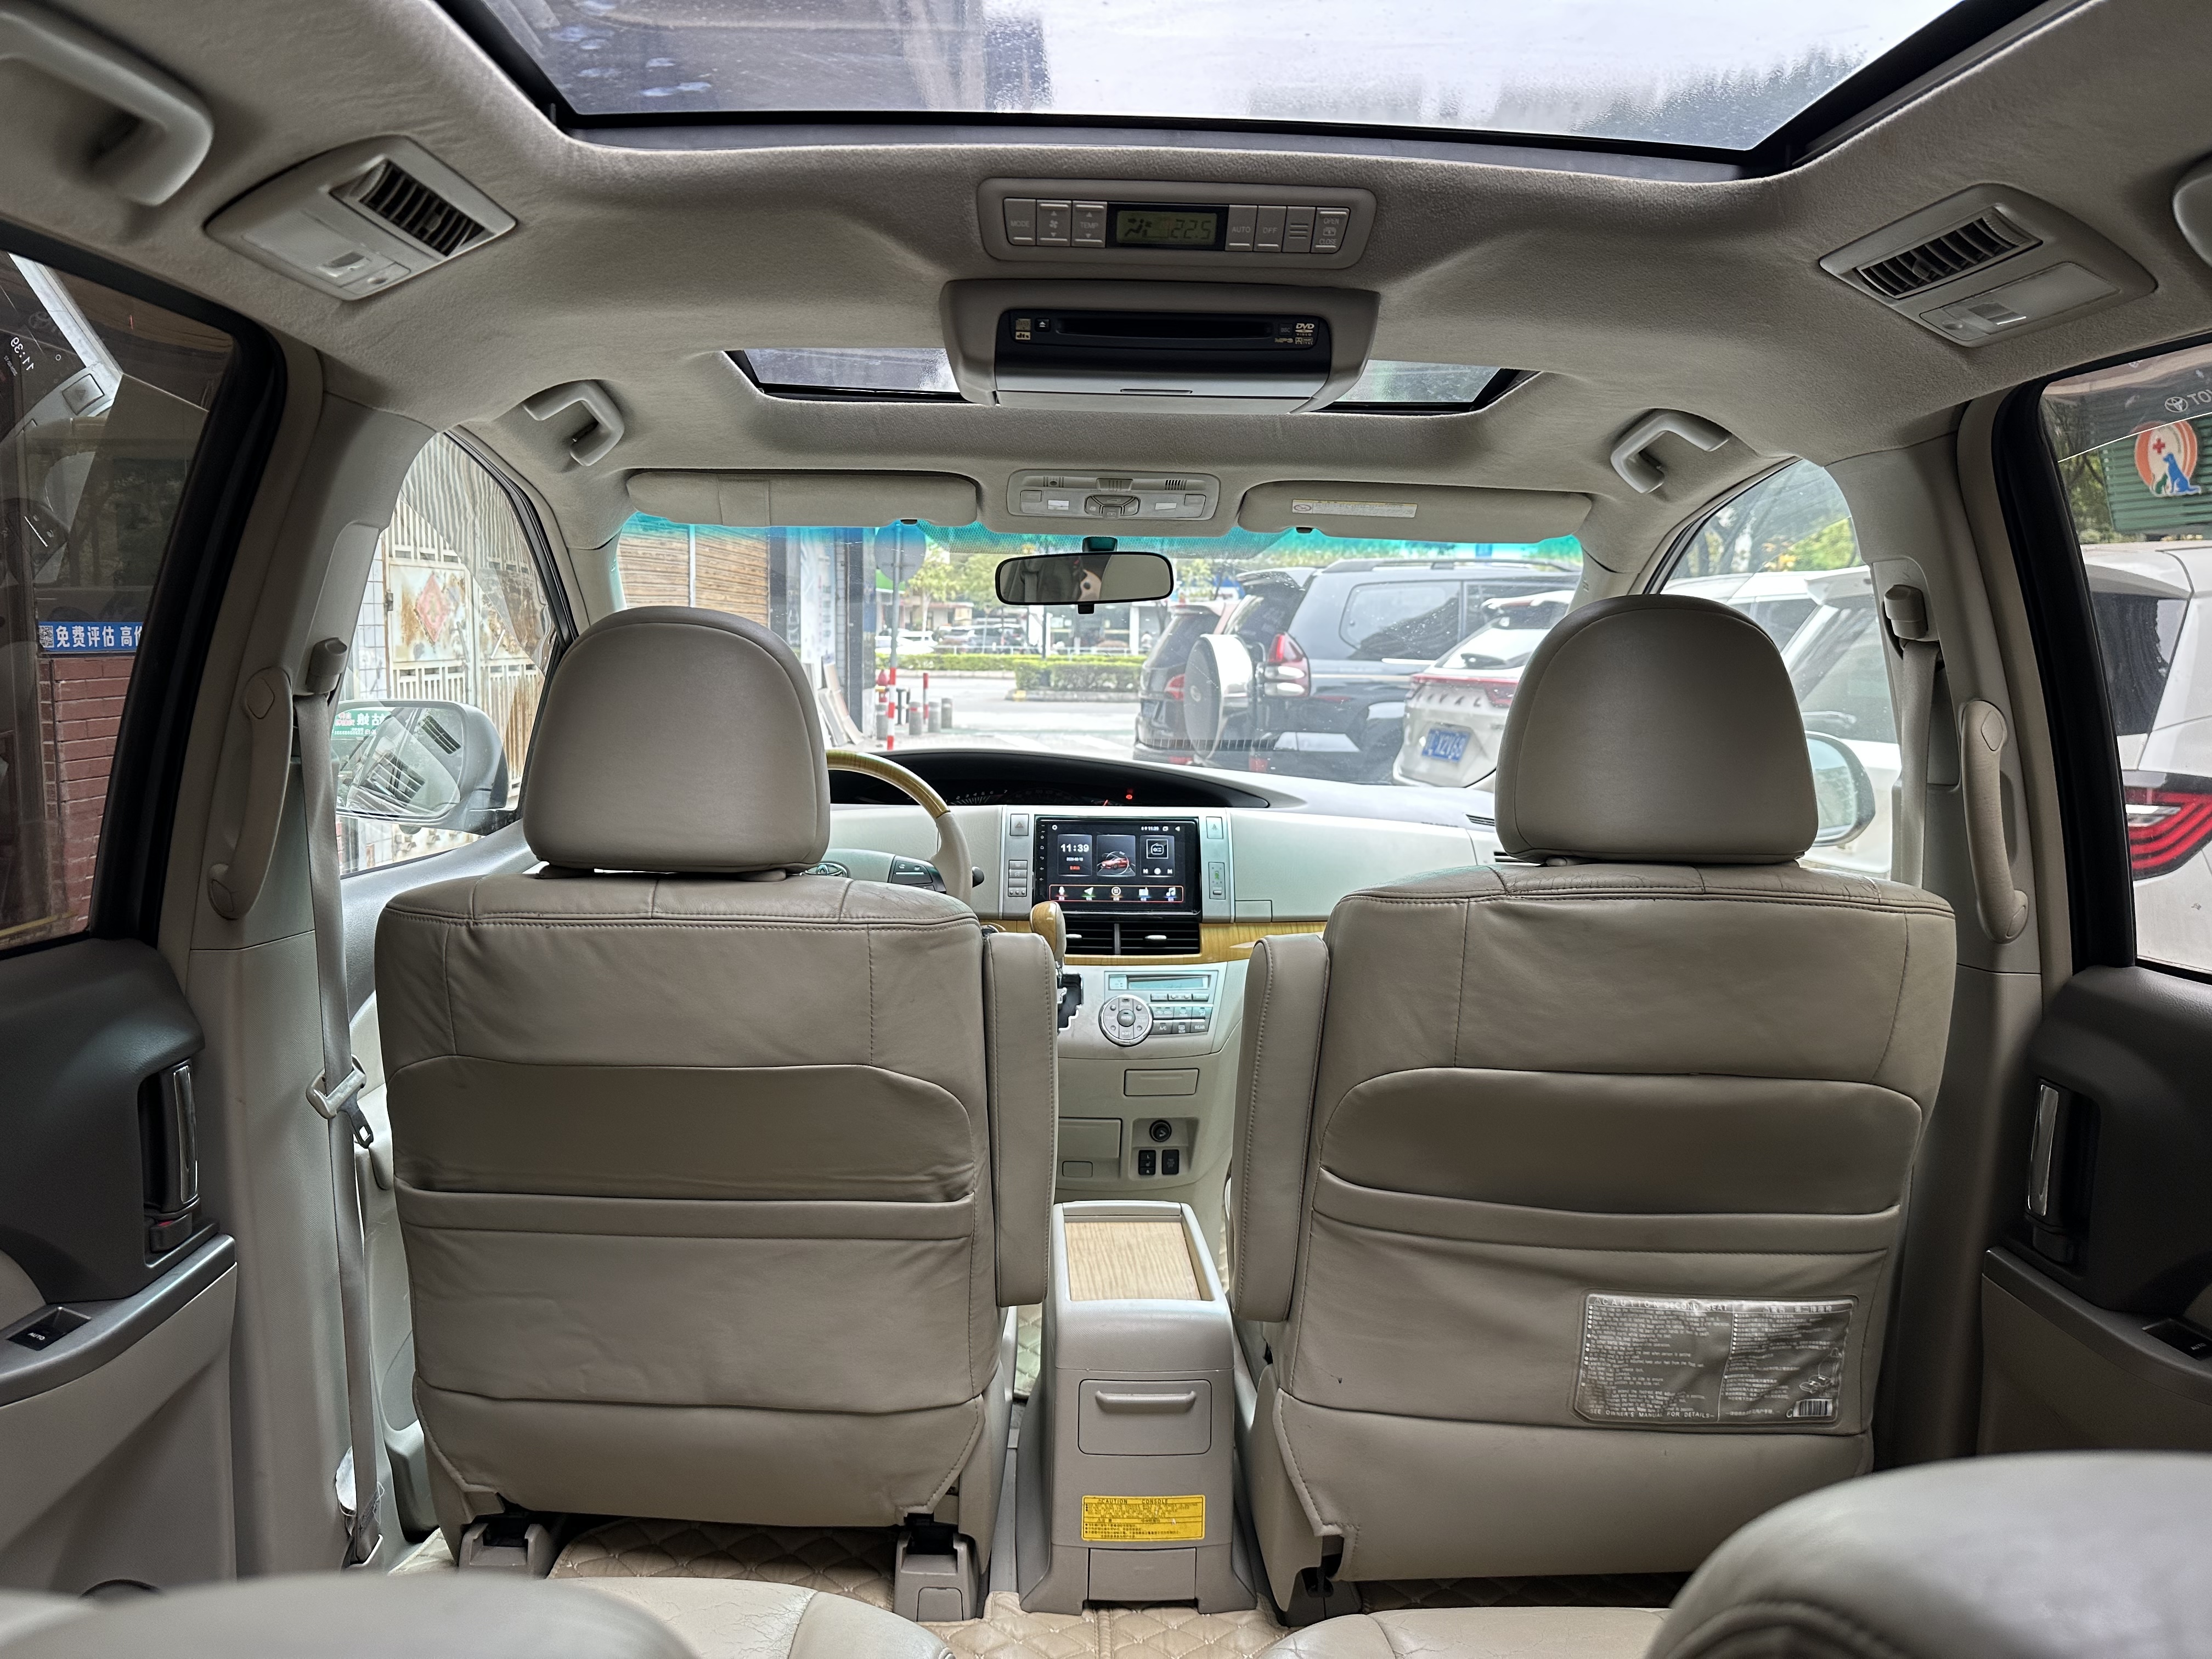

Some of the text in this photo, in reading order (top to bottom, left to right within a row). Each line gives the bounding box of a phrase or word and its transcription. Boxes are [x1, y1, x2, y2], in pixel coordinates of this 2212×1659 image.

[56, 625, 115, 647] 免费评估
[1060, 843, 1089, 853] 11:39
[1602, 1298, 1728, 1311] CAUTION SECOND SEAT
